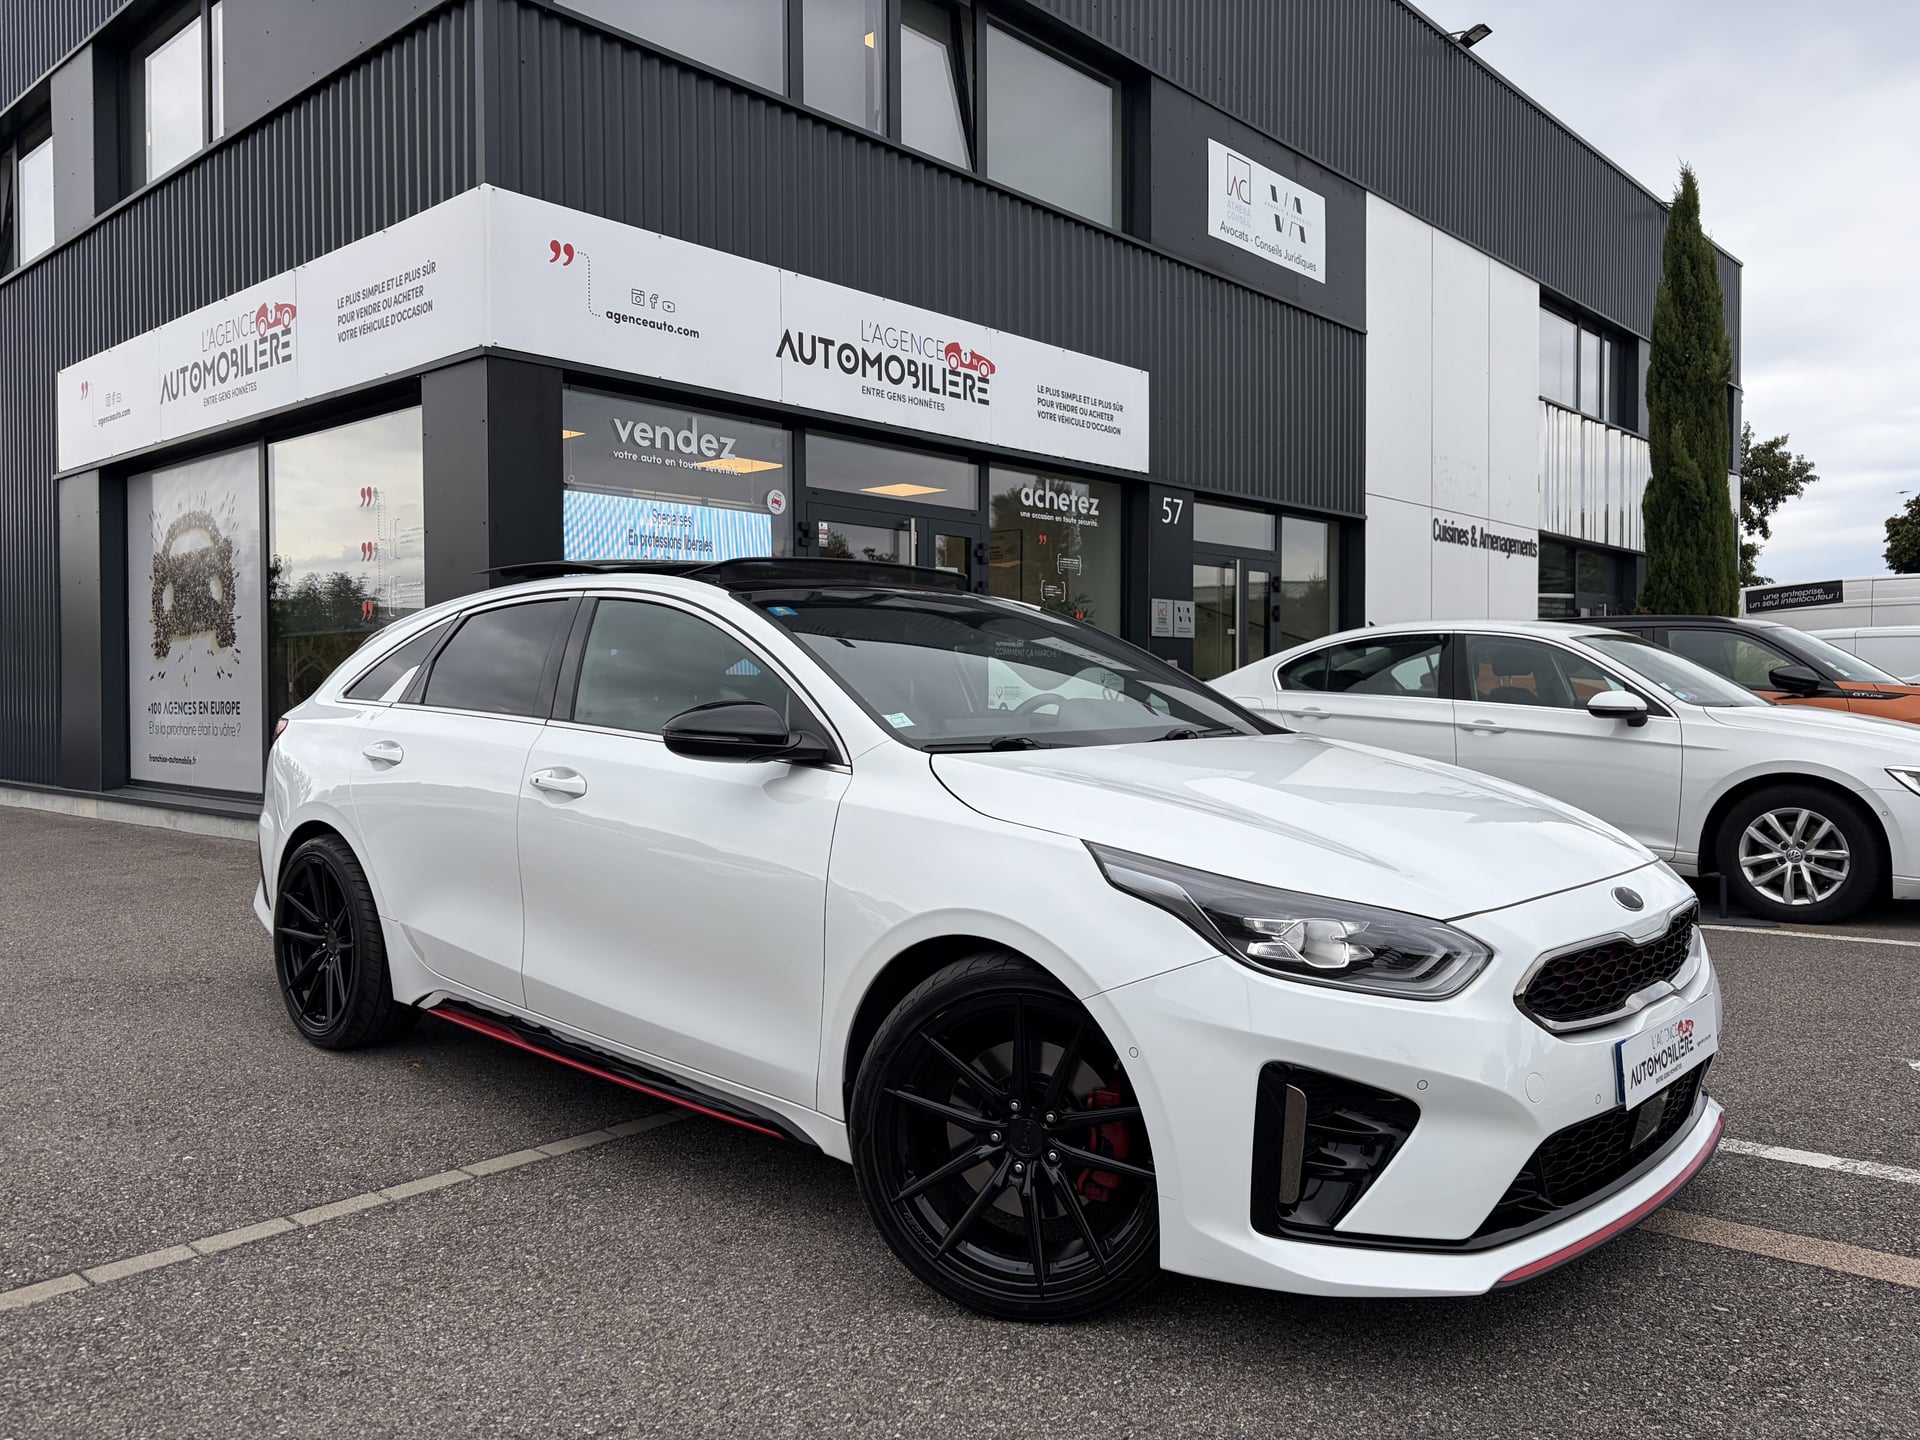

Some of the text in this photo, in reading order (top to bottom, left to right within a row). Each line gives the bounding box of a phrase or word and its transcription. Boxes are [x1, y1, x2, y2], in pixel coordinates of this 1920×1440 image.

[1220, 221, 1249, 242] Avocats
[1254, 235, 1283, 259] Conseils
[1284, 249, 1317, 272] Juridiques
[337, 259, 436, 309] LE PLUS SIMPLE ET LE PLUS SÛR
[337, 284, 424, 326] POUR VENDRE OU ACHETER
[202, 310, 256, 352] L'AGENCE
[337, 299, 433, 343] VOTRE VÉHICULE D'OCCASION
[606, 309, 700, 339] agenceauto.com
[861, 320, 945, 362] L'AGENCE
[203, 381, 258, 407] ENTRE GENS HONNÊTES
[861, 385, 945, 411] ENTRE GENS HONNÊTES
[1037, 384, 1124, 413] LE PLUS SIMPLE ET LE PLUS SÛR
[1037, 397, 1114, 422] POUR VENDRE OU ACHETER
[1037, 409, 1121, 435] VOTRE VÉHICULE D'OCCASION
[613, 416, 737, 459] vendez
[613, 450, 638, 461] votre
[640, 454, 662, 464] auto
[665, 459, 676, 467] en
[679, 459, 702, 471] toute
[1020, 479, 1100, 516] achetez
[1161, 496, 1183, 525] 57
[1031, 512, 1054, 521] occasion
[1063, 516, 1077, 524] toute
[628, 529, 638, 546] En
[640, 532, 682, 550] professions
[1433, 517, 1469, 547] Cuisines
[1470, 525, 1477, 548] &
[1749, 601, 1761, 609] un
[1762, 598, 1780, 607] seul
[1780, 593, 1834, 605] interlocuteur
[1763, 593, 1780, 601] une
[995, 647, 1024, 657] COMMENT
[1025, 648, 1034, 658] ÇA
[148, 701, 241, 715] +100 AGENCES EN EUROPE
[166, 722, 197, 738] prochaine
